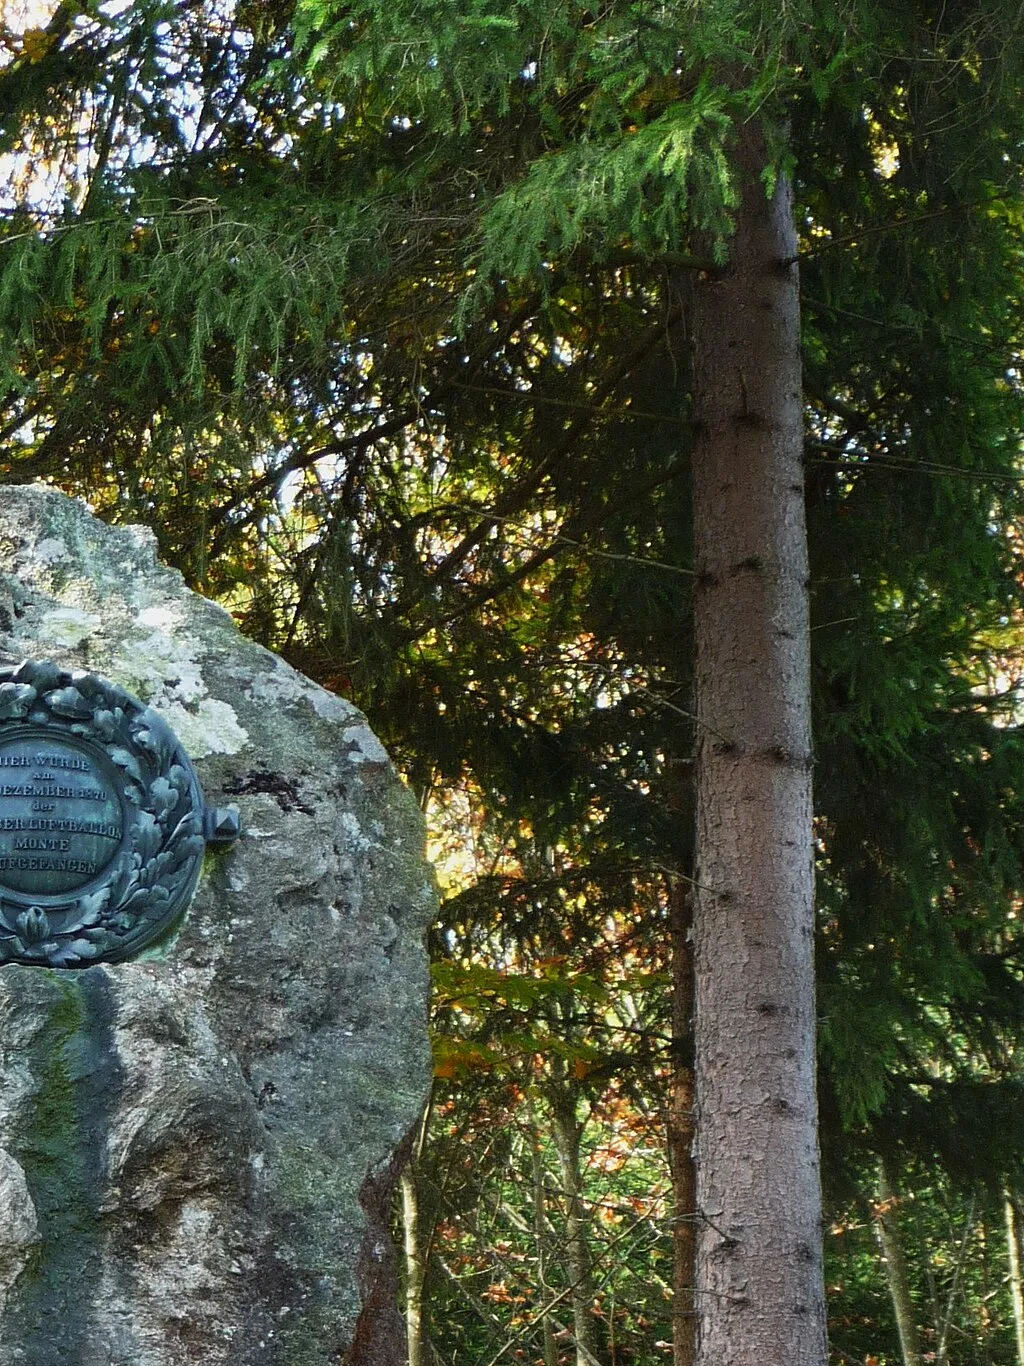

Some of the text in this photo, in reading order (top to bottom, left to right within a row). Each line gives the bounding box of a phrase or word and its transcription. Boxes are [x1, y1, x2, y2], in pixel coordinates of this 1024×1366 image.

[33, 757, 90, 771] WURDE
[33, 800, 55, 811] der
[28, 819, 122, 840] LUFTBALLON
[15, 838, 70, 850] MONTE
